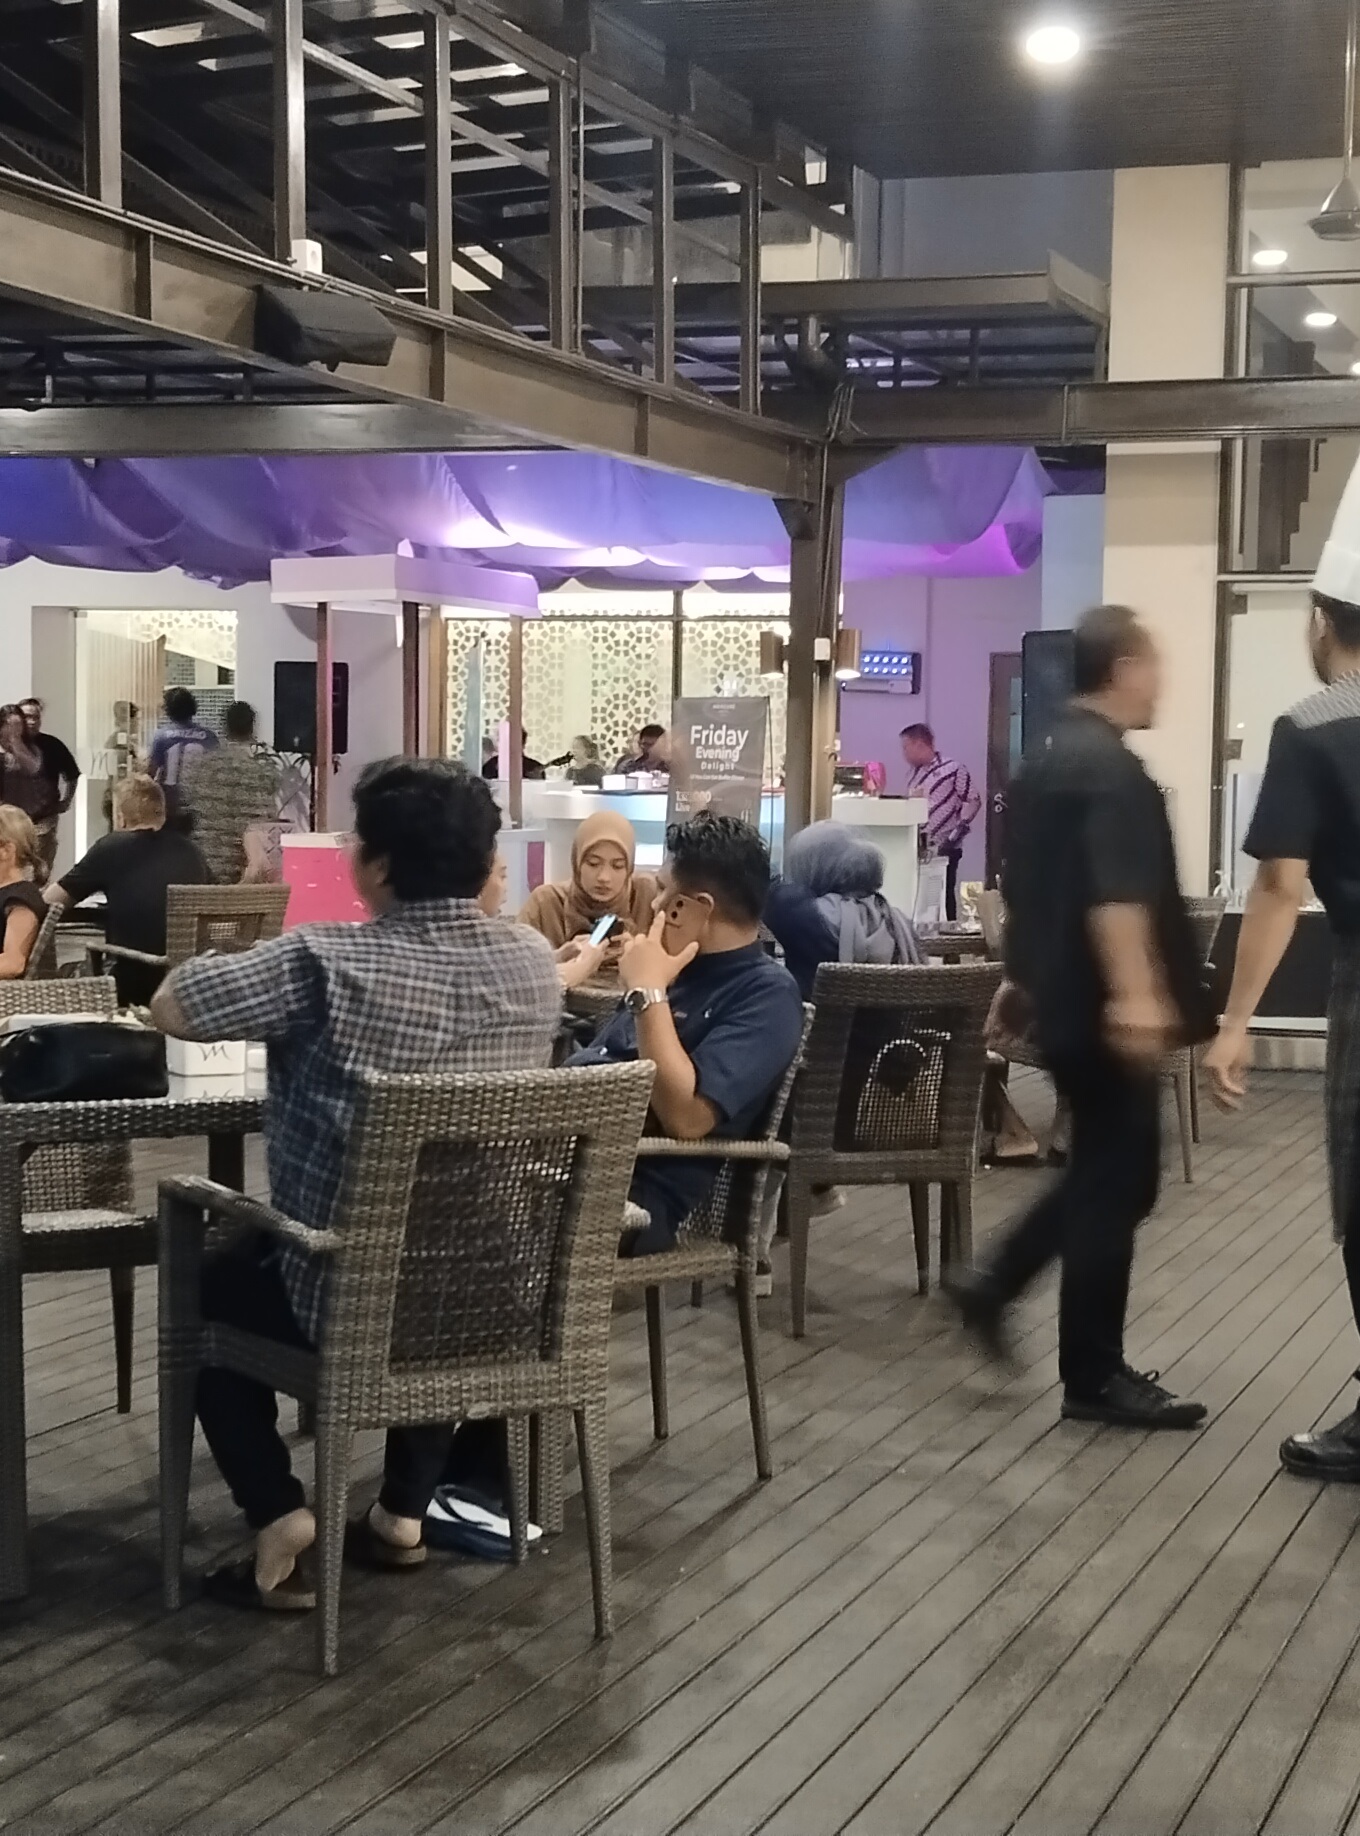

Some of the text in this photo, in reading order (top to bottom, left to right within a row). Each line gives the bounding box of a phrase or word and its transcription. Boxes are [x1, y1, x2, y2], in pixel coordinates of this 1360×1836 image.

[690, 723, 749, 750] Friday
[695, 745, 741, 762] Evening
[700, 761, 735, 772] Delight
